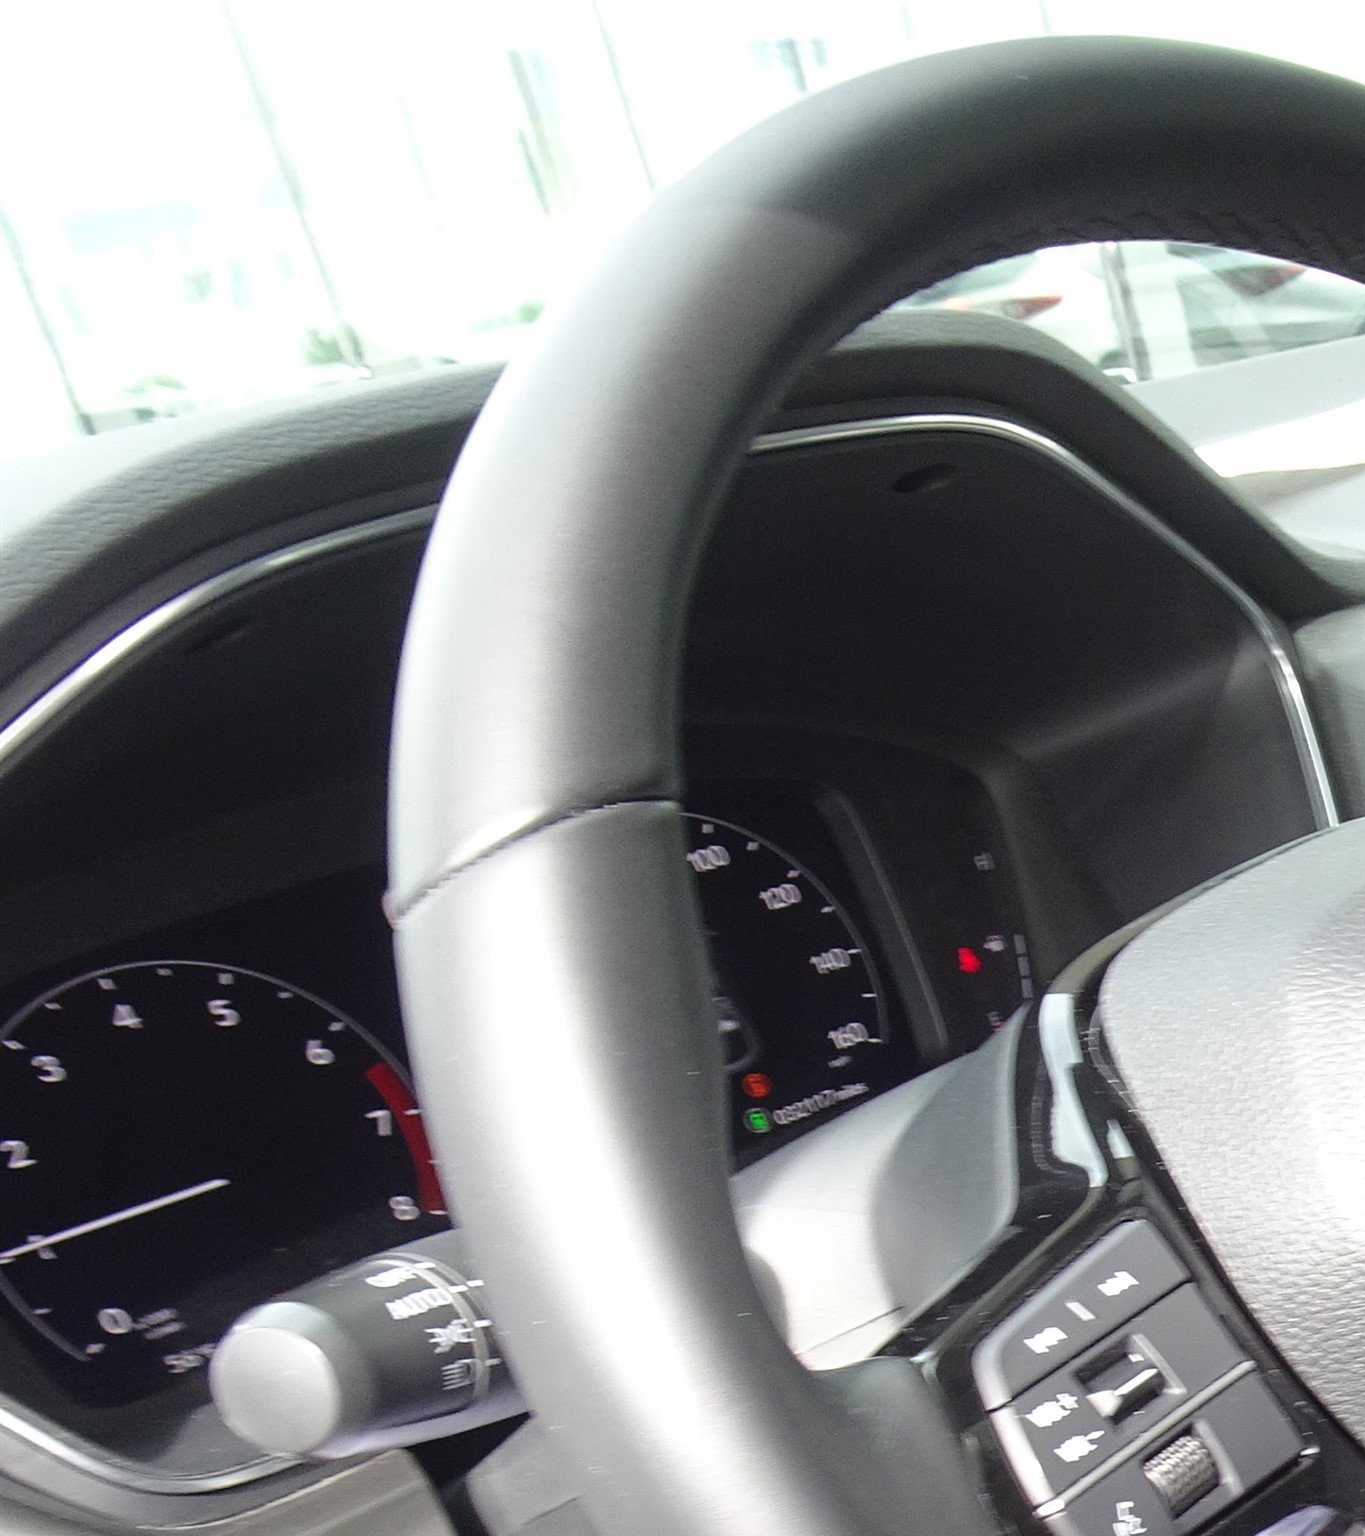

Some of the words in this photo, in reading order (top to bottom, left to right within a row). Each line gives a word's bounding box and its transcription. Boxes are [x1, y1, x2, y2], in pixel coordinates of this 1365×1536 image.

[112, 1003, 143, 1029] 4
[207, 999, 241, 1026] 5
[827, 1022, 869, 1049] 160
[305, 1039, 335, 1065] 6
[31, 1055, 66, 1082] 3
[364, 1109, 392, 1137] 7
[0, 1140, 37, 1169] 2
[388, 1195, 420, 1221] 8
[386, 1286, 447, 1320] AUTO
[98, 1308, 134, 1335] 0
